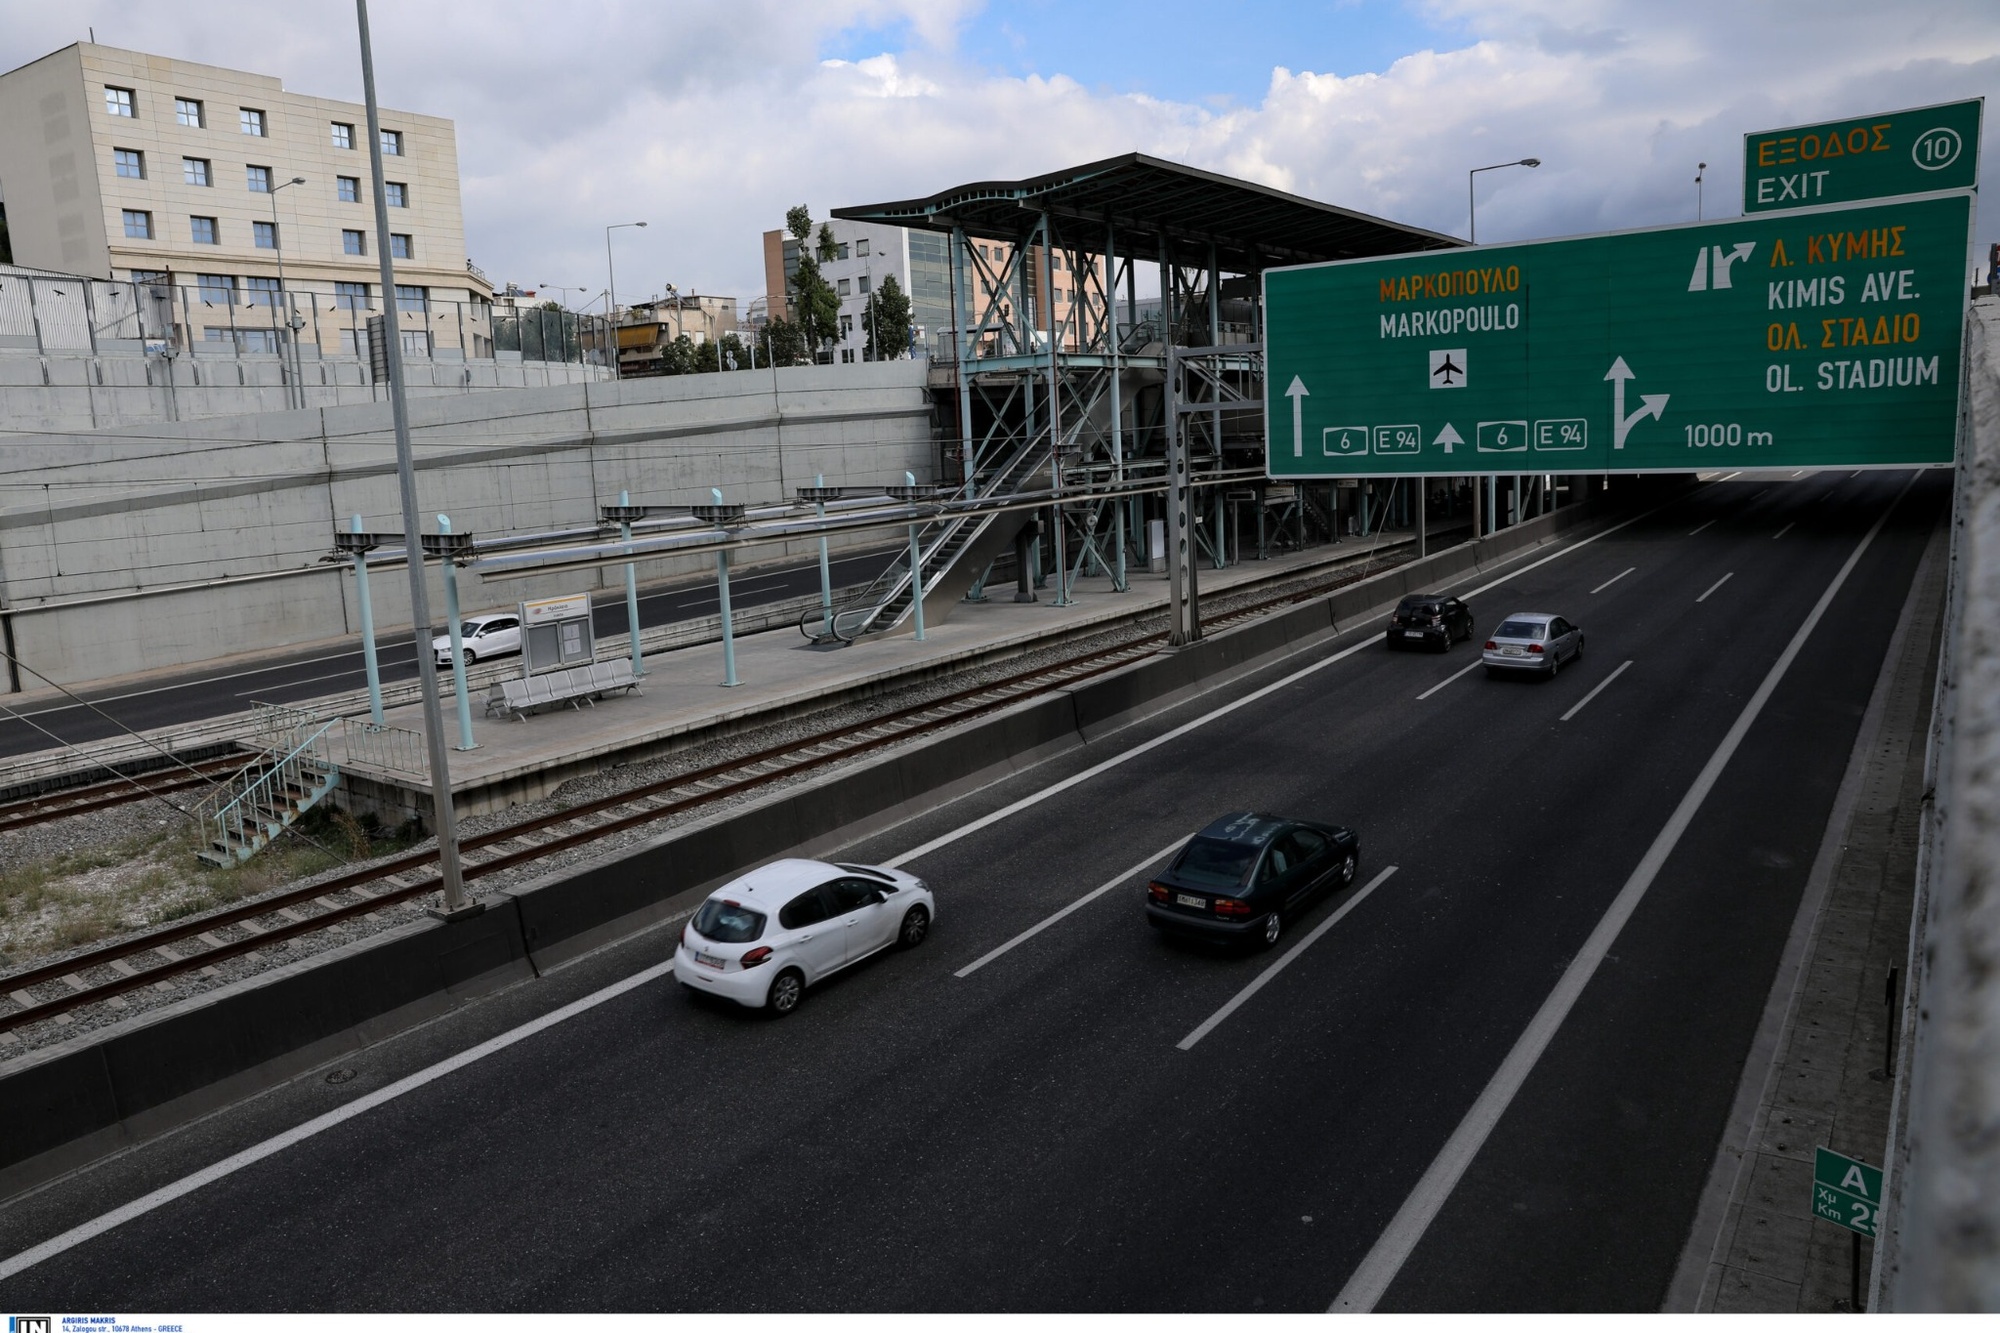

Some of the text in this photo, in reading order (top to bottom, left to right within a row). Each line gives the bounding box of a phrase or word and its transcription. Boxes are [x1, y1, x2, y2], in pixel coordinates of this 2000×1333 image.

[1758, 124, 1891, 166] ΕΞΟΔΟΣ
[1924, 137, 1951, 161] 10
[1757, 171, 1829, 203] EXIT
[1771, 227, 1905, 267] Λ. ΚΥΜΗΣ
[1381, 265, 1519, 301] ΜΑΡΚΟΠΟΥΛΟ
[1768, 269, 1921, 310] KIMIS AVE.
[1381, 304, 1519, 339] MARKOPOULO
[1768, 313, 1919, 351] ΟΛ. ΣΤΑΔΙΟ
[1766, 355, 1939, 393] OL. STADIUM
[1340, 432, 1350, 449] 6
[1379, 430, 1416, 448] E 94
[1497, 427, 1508, 445] 6
[1540, 424, 1582, 444] E 94
[1685, 423, 1773, 449] 1000 m
[1817, 1202, 1842, 1221] Km
